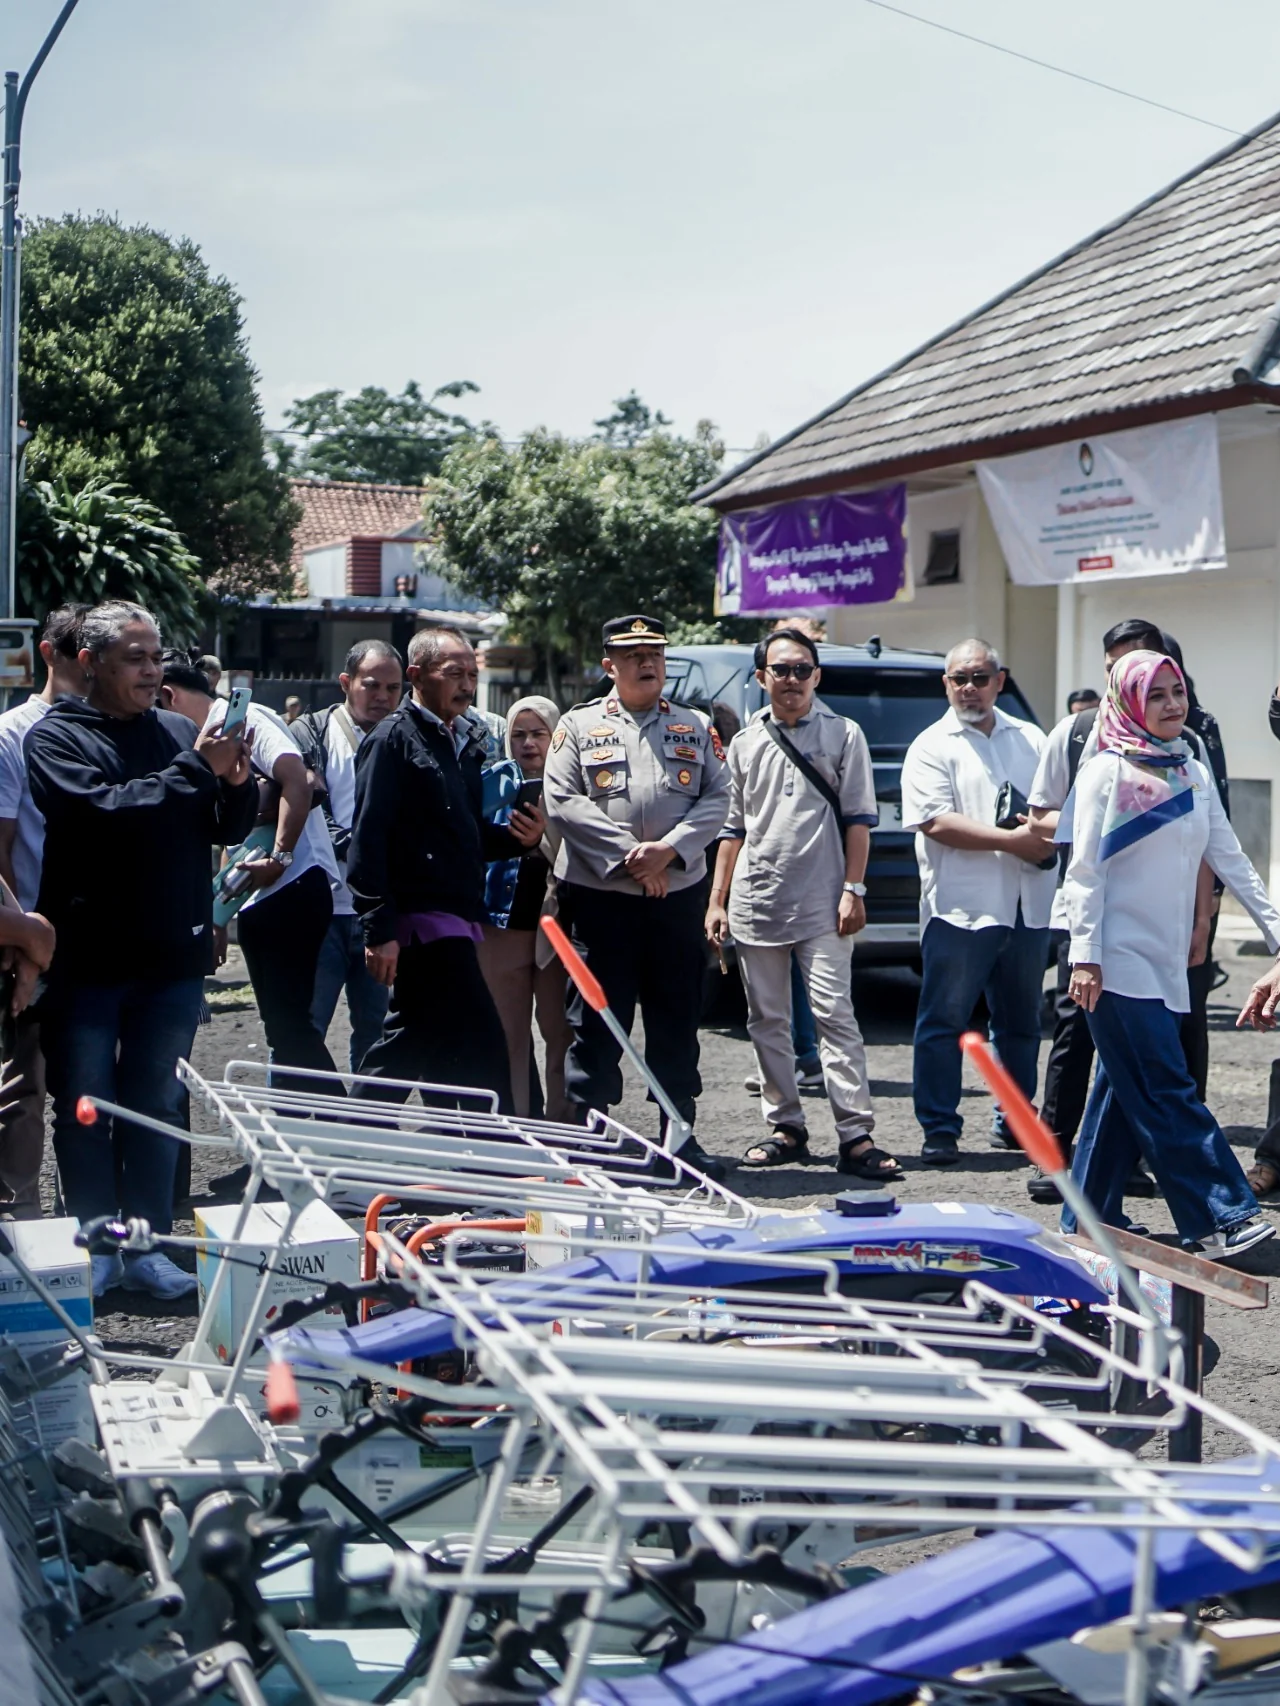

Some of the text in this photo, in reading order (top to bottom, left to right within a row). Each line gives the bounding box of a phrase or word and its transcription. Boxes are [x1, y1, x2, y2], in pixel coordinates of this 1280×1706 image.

[586, 736, 620, 747] ALAN
[664, 735, 701, 746] POLRI
[280, 1255, 325, 1275] SWAN
